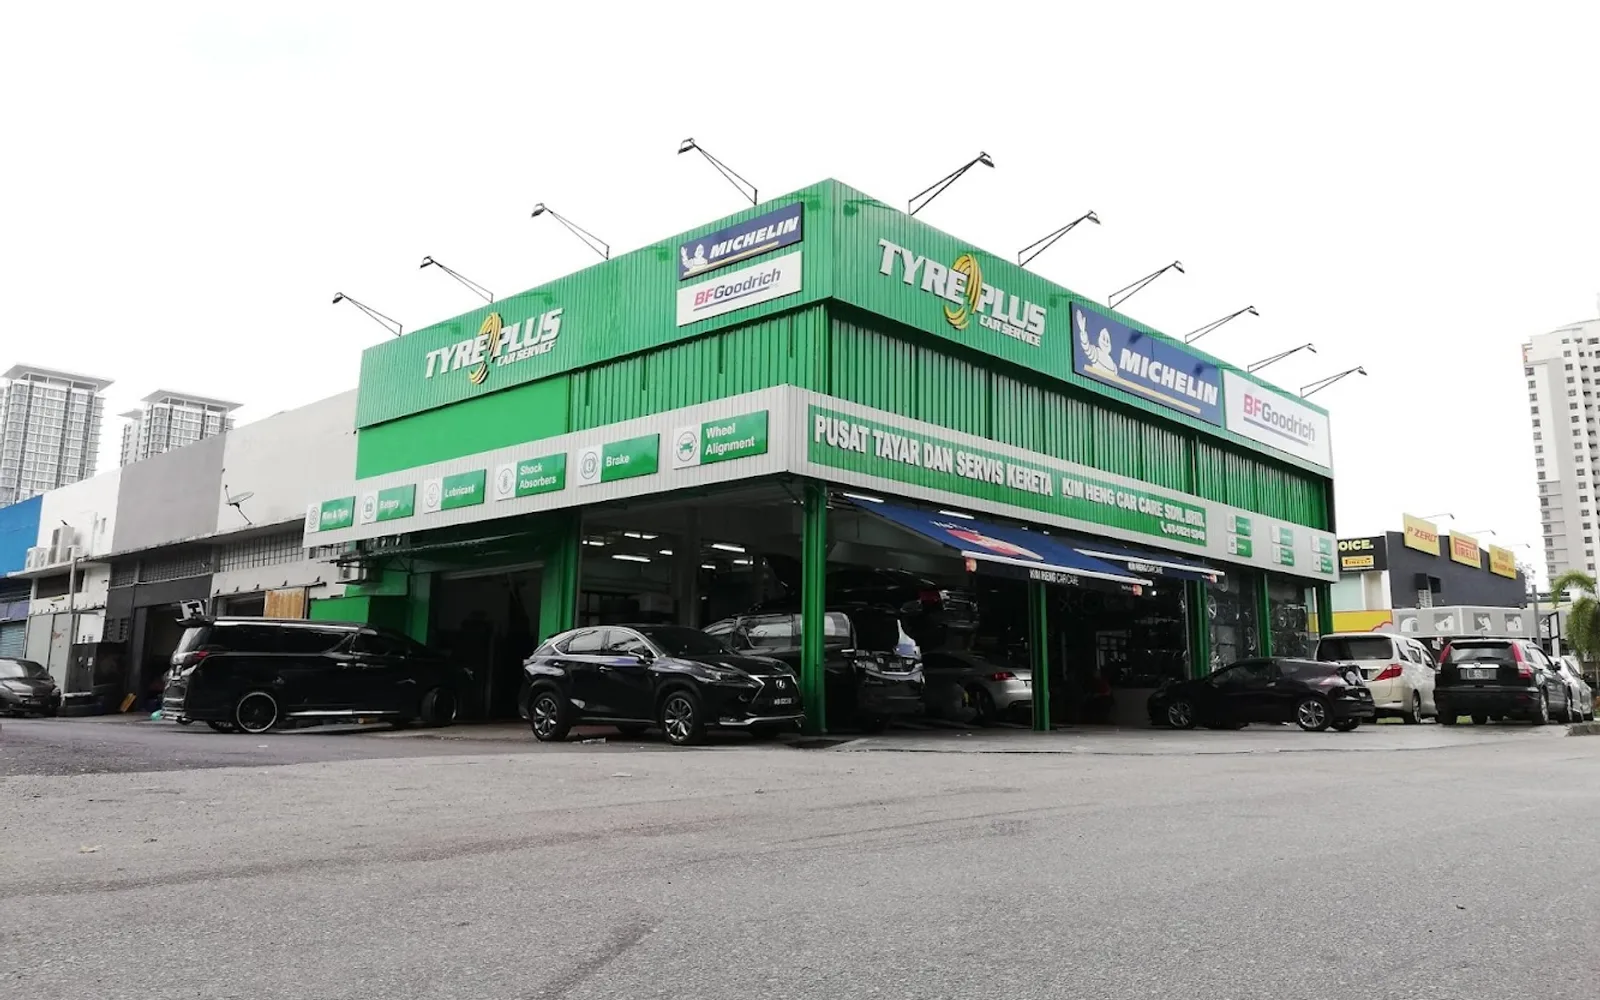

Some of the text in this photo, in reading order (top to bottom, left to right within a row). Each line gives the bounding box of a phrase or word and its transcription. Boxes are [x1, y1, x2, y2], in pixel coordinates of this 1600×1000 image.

[709, 216, 799, 259] MICHELIN
[694, 268, 781, 306] BFGoodrich
[980, 315, 1041, 347] CAR SERVICE
[497, 352, 516, 367] CAR
[1119, 348, 1218, 406] MICHELIN
[1243, 393, 1316, 442] BFGoodrich
[705, 422, 736, 439] Wheel
[705, 436, 755, 456] Alignment
[814, 413, 1053, 496] PUSAT TAYAR DAN SERVIS KERETA
[520, 463, 543, 476] Shock
[606, 454, 630, 467] Brake
[444, 484, 475, 498] Lubricant
[519, 475, 556, 489] Absorbers
[1062, 477, 1084, 499] KIM
[1085, 483, 1116, 505] HENG
[1117, 491, 1137, 511] CAR
[1139, 496, 1163, 518] CARE
[1414, 528, 1437, 542] ZERO
